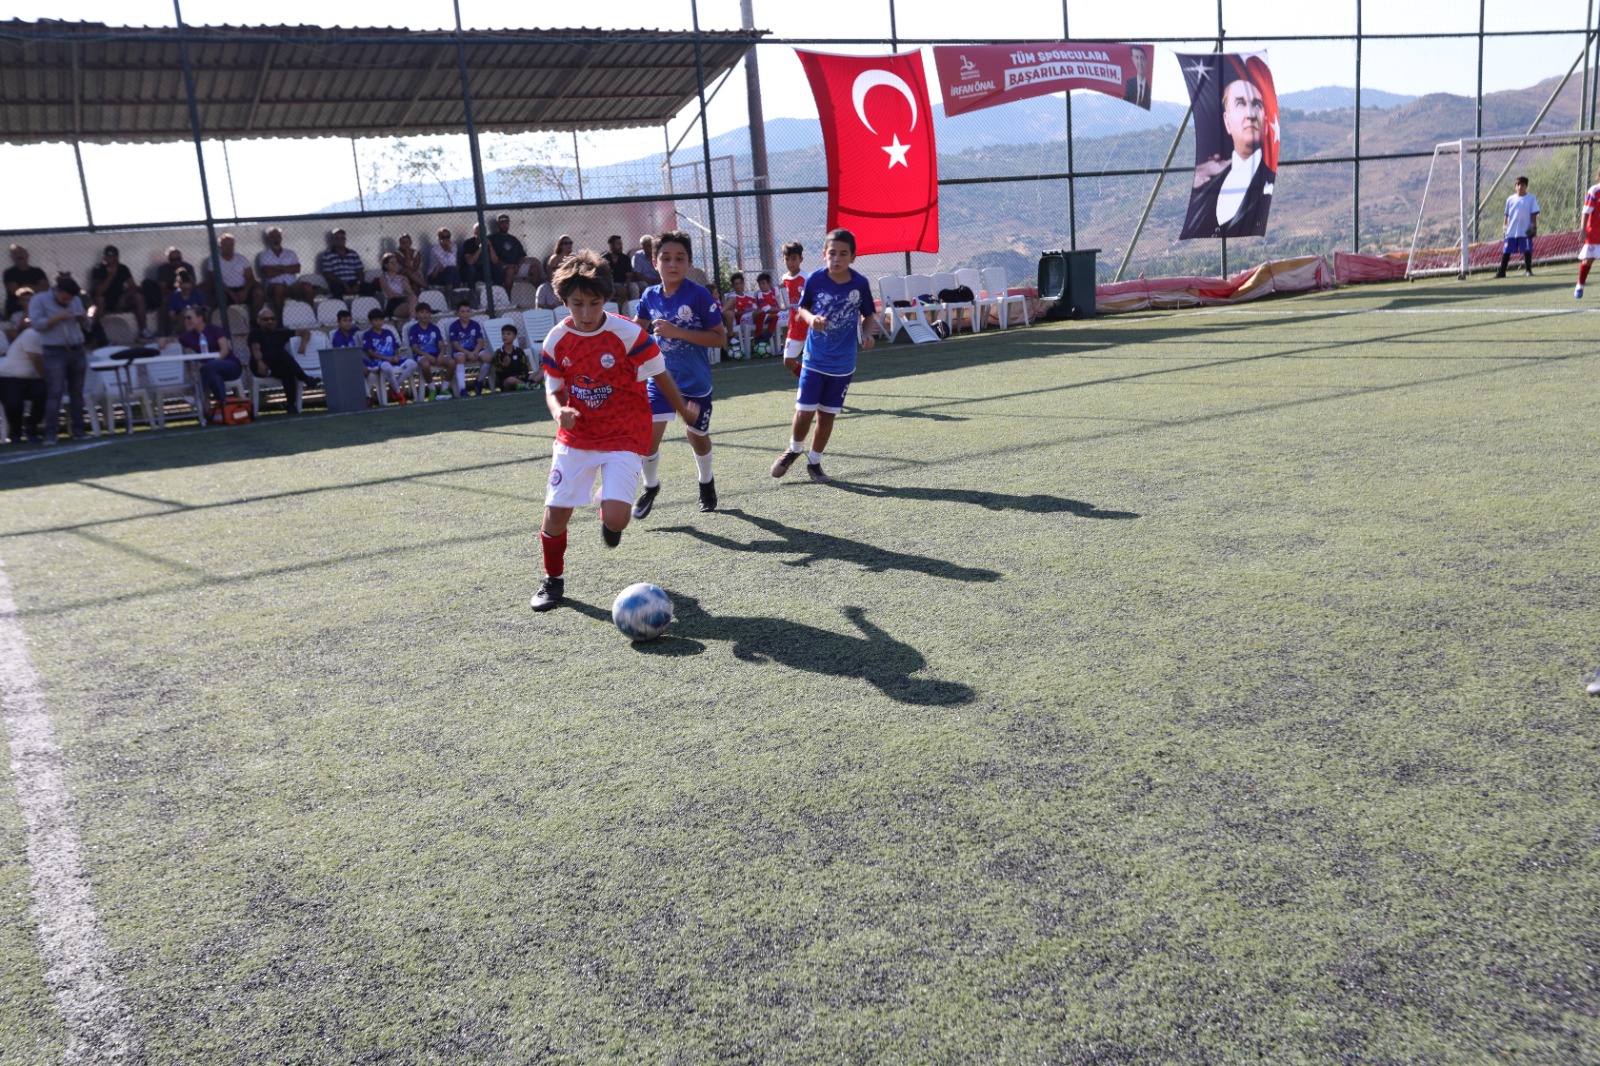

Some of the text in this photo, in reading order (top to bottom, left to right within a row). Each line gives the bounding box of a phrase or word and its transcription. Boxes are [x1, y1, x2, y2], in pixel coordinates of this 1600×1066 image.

[1010, 50, 1110, 65] TÜM SPORCULARA
[1009, 63, 1121, 86] BAŞARILAR DİLERİM.
[950, 84, 974, 97] İRFAN
[974, 80, 996, 92] ÖNAL
[593, 385, 613, 394] KIDS
